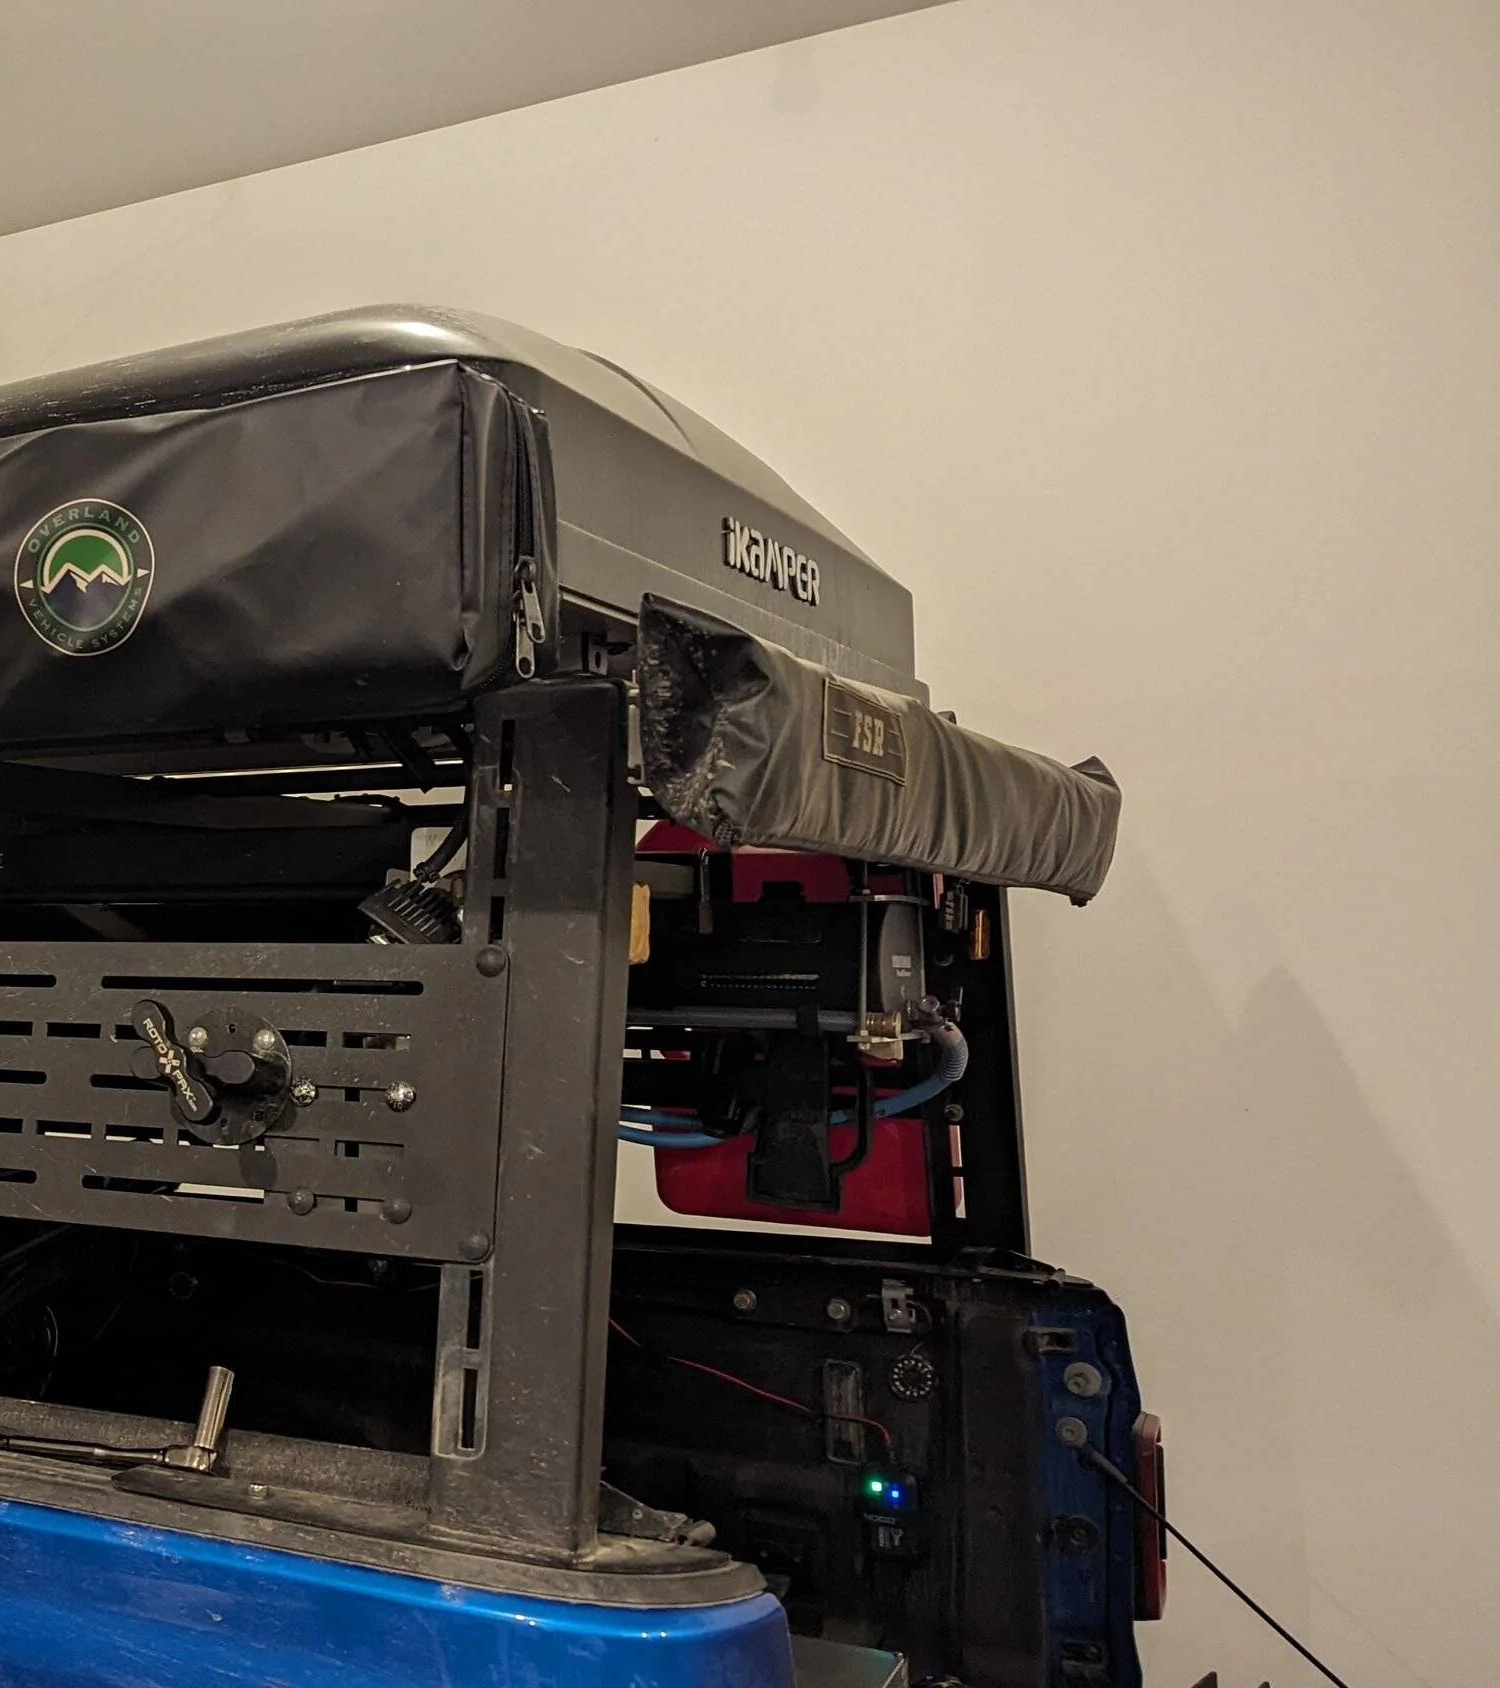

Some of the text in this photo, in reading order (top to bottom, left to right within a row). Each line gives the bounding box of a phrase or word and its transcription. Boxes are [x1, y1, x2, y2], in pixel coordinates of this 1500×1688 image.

[28, 506, 141, 554] OVERLAND
[29, 588, 142, 649] VEHICLE SYSTEMS
[142, 1018, 168, 1054] ROTO
